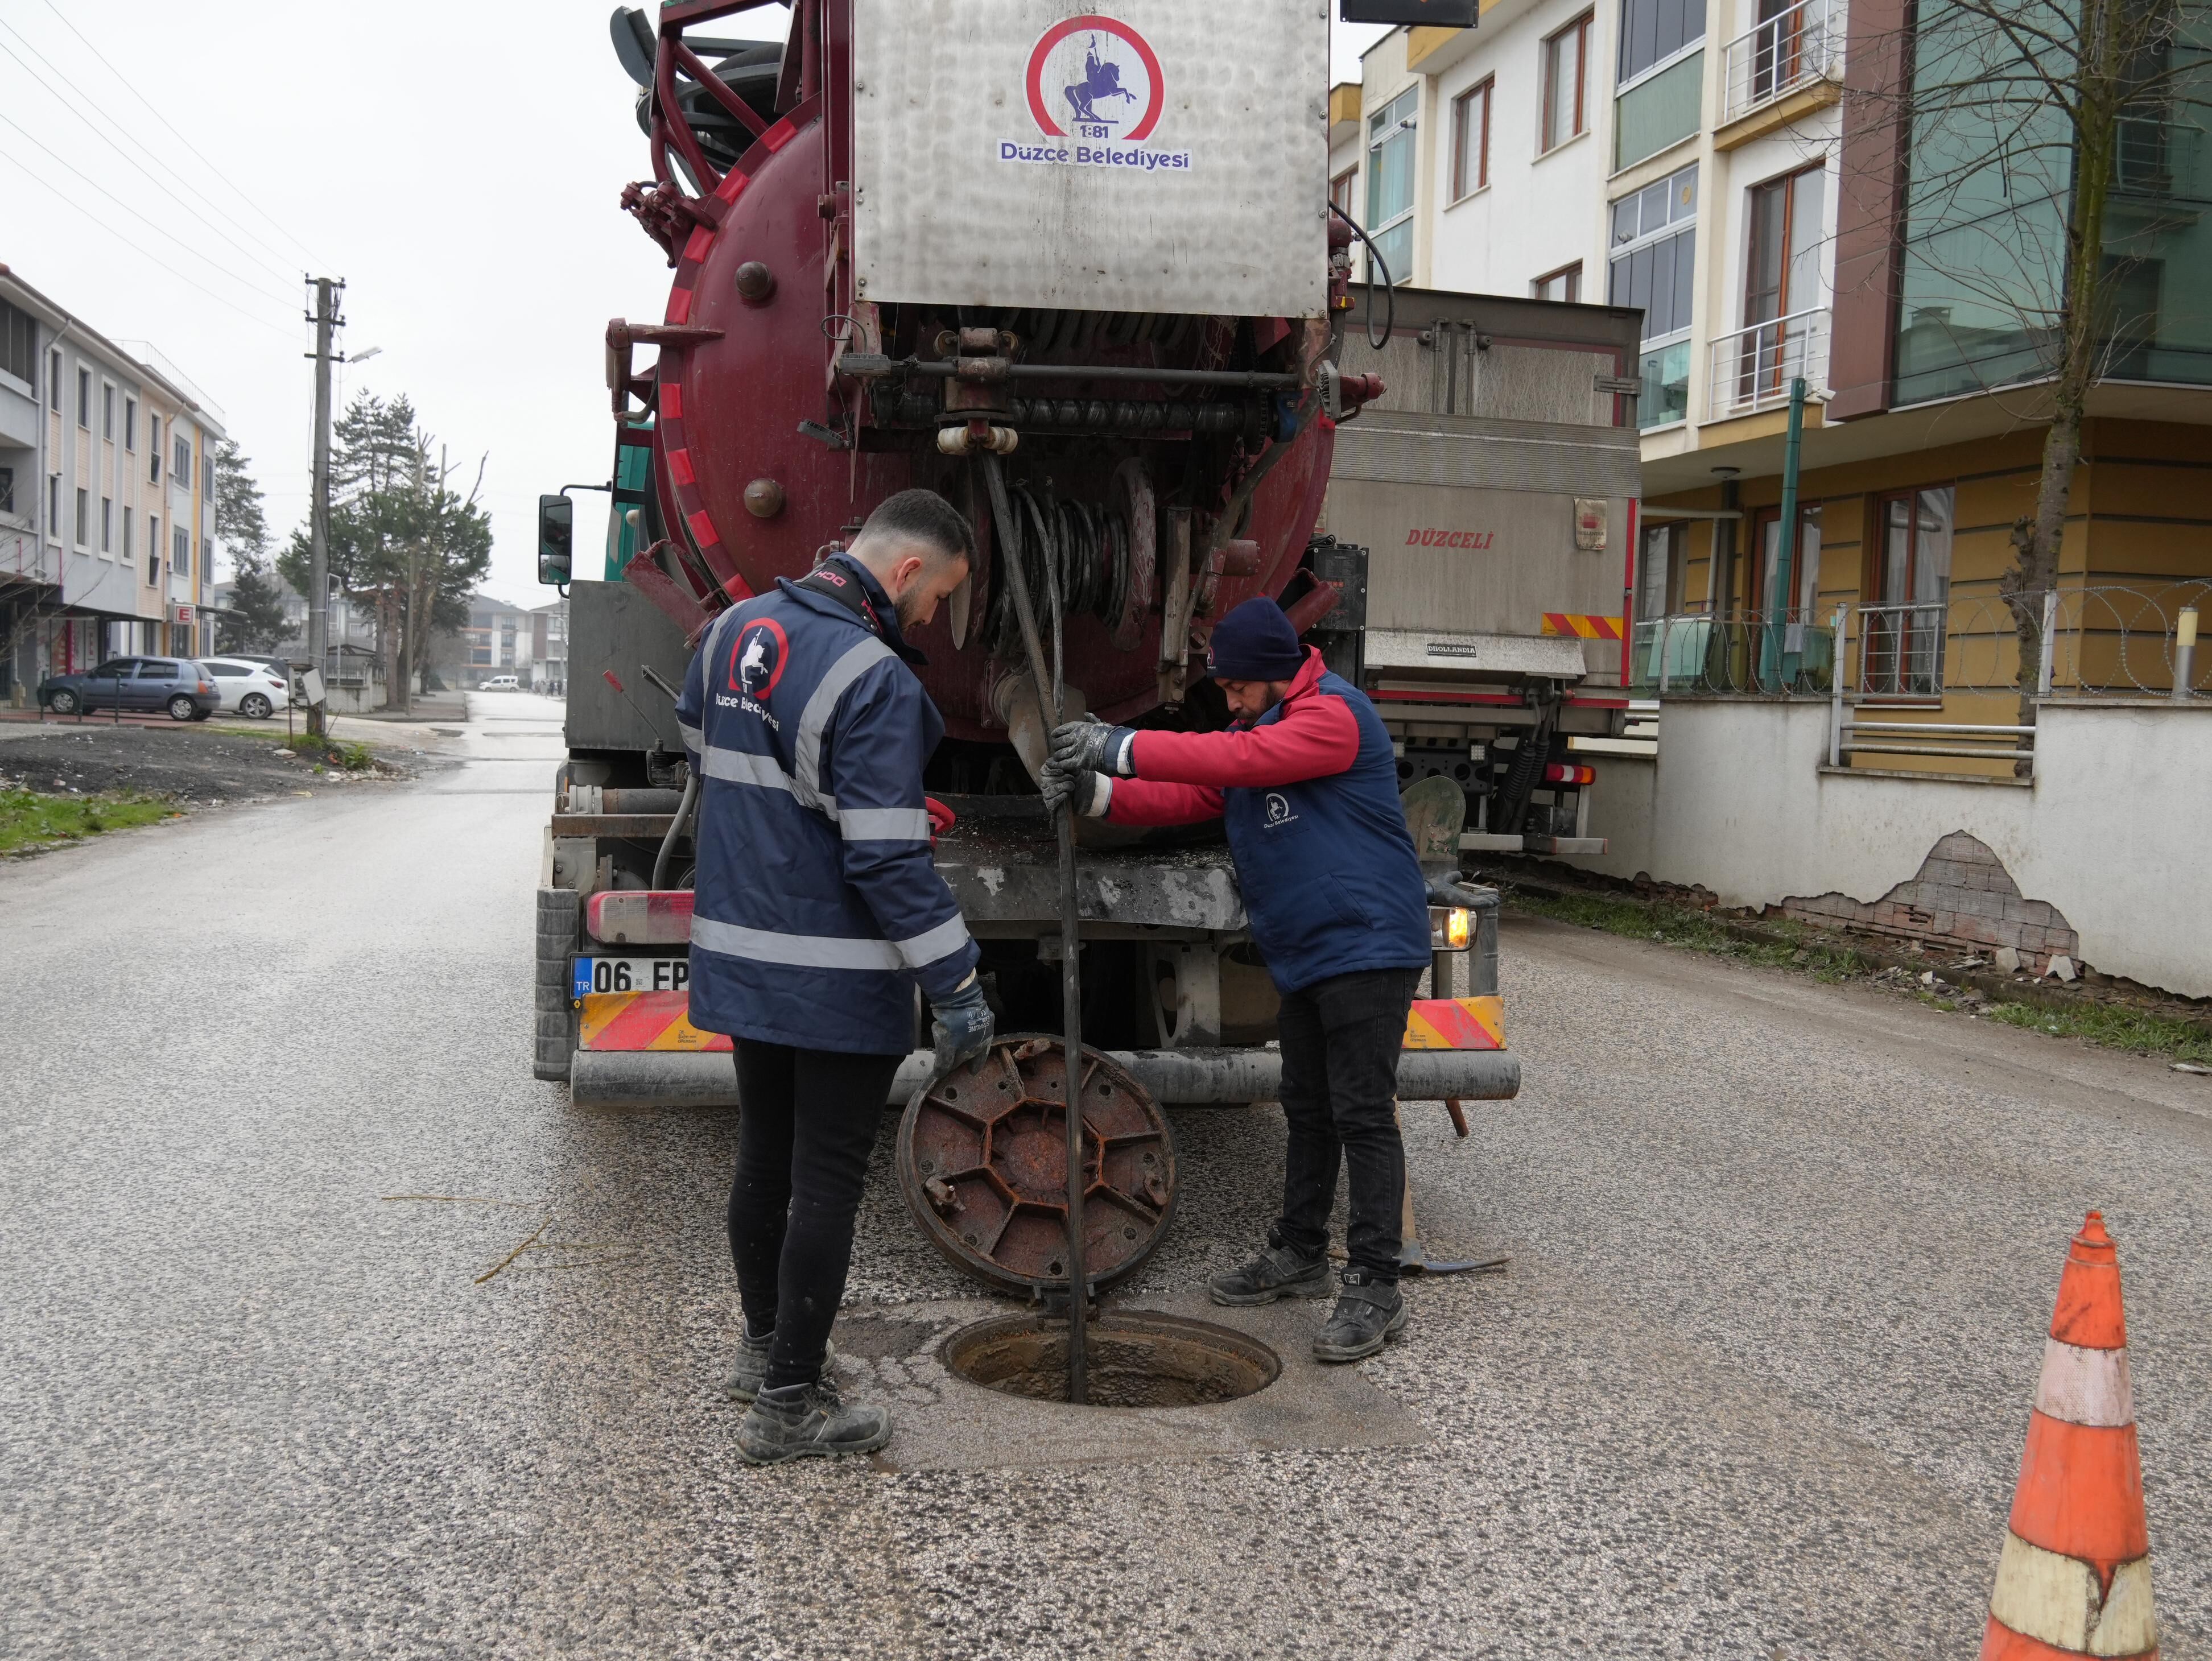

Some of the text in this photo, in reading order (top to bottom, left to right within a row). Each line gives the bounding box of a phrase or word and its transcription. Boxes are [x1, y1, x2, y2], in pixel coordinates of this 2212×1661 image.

[1081, 126, 1108, 139] 1881
[1001, 143, 1188, 170] Düzce Belediyesi
[1405, 528, 1494, 549] DÜZCELİ
[179, 608, 190, 621] E
[594, 961, 632, 993] 06
[576, 982, 590, 991] TR
